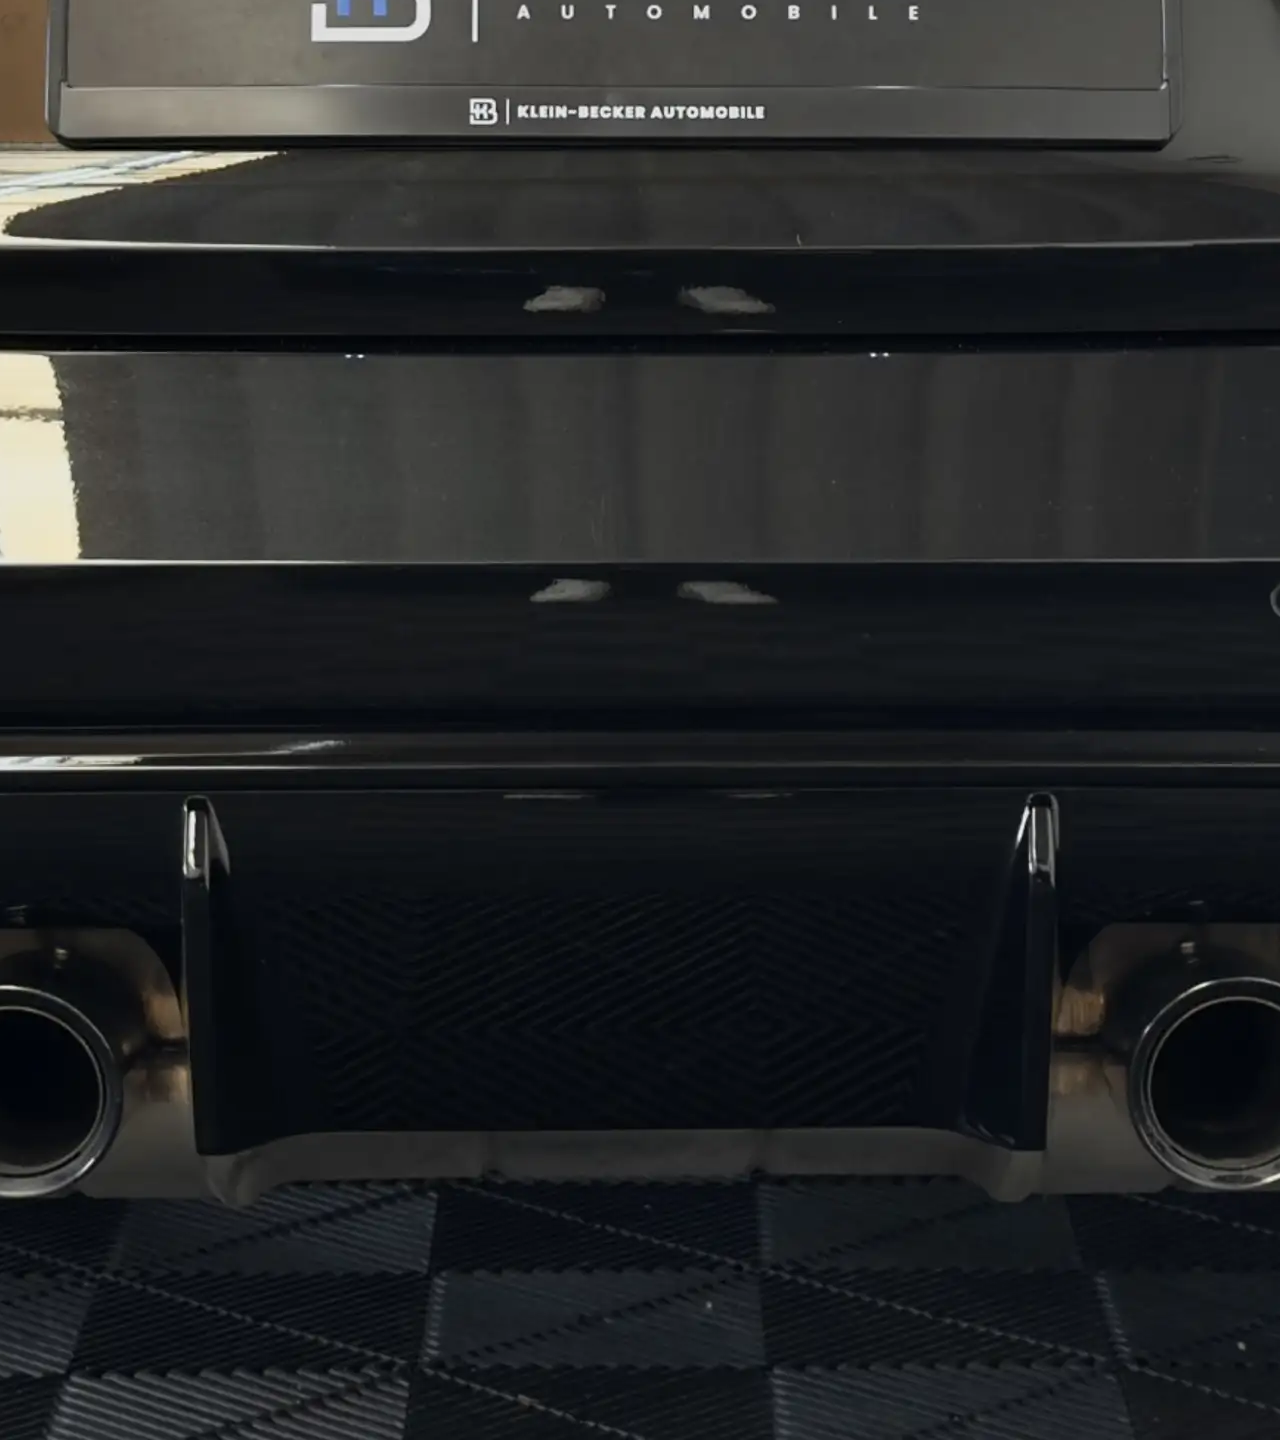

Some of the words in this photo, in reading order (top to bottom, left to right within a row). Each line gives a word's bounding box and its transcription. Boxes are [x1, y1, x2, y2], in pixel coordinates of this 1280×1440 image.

[516, 4, 920, 21] AUTOMOBILE
[517, 104, 646, 119] KLEIN-BECKER
[650, 106, 766, 120] AUTOMOBILE
